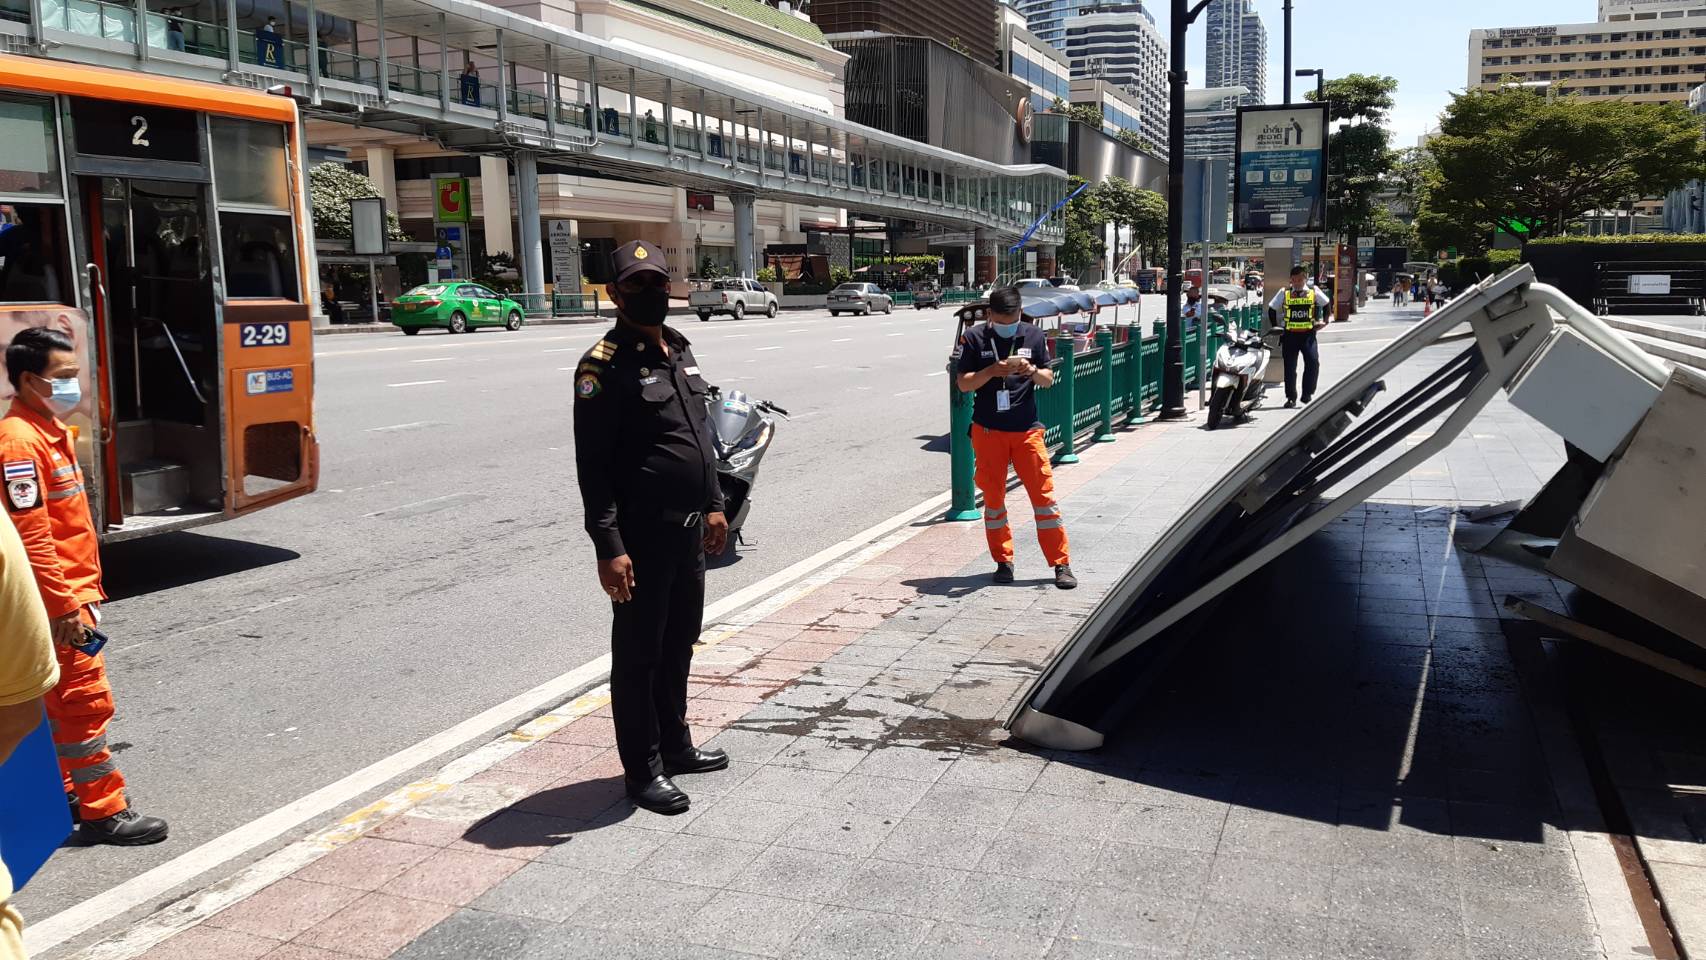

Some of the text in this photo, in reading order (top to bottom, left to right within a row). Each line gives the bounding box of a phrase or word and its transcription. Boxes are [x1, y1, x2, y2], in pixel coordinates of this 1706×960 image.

[266, 43, 275, 60] R
[131, 115, 149, 147] 2
[441, 181, 461, 213] C
[1291, 310, 1309, 319] RGH
[243, 324, 287, 346] 2-29
